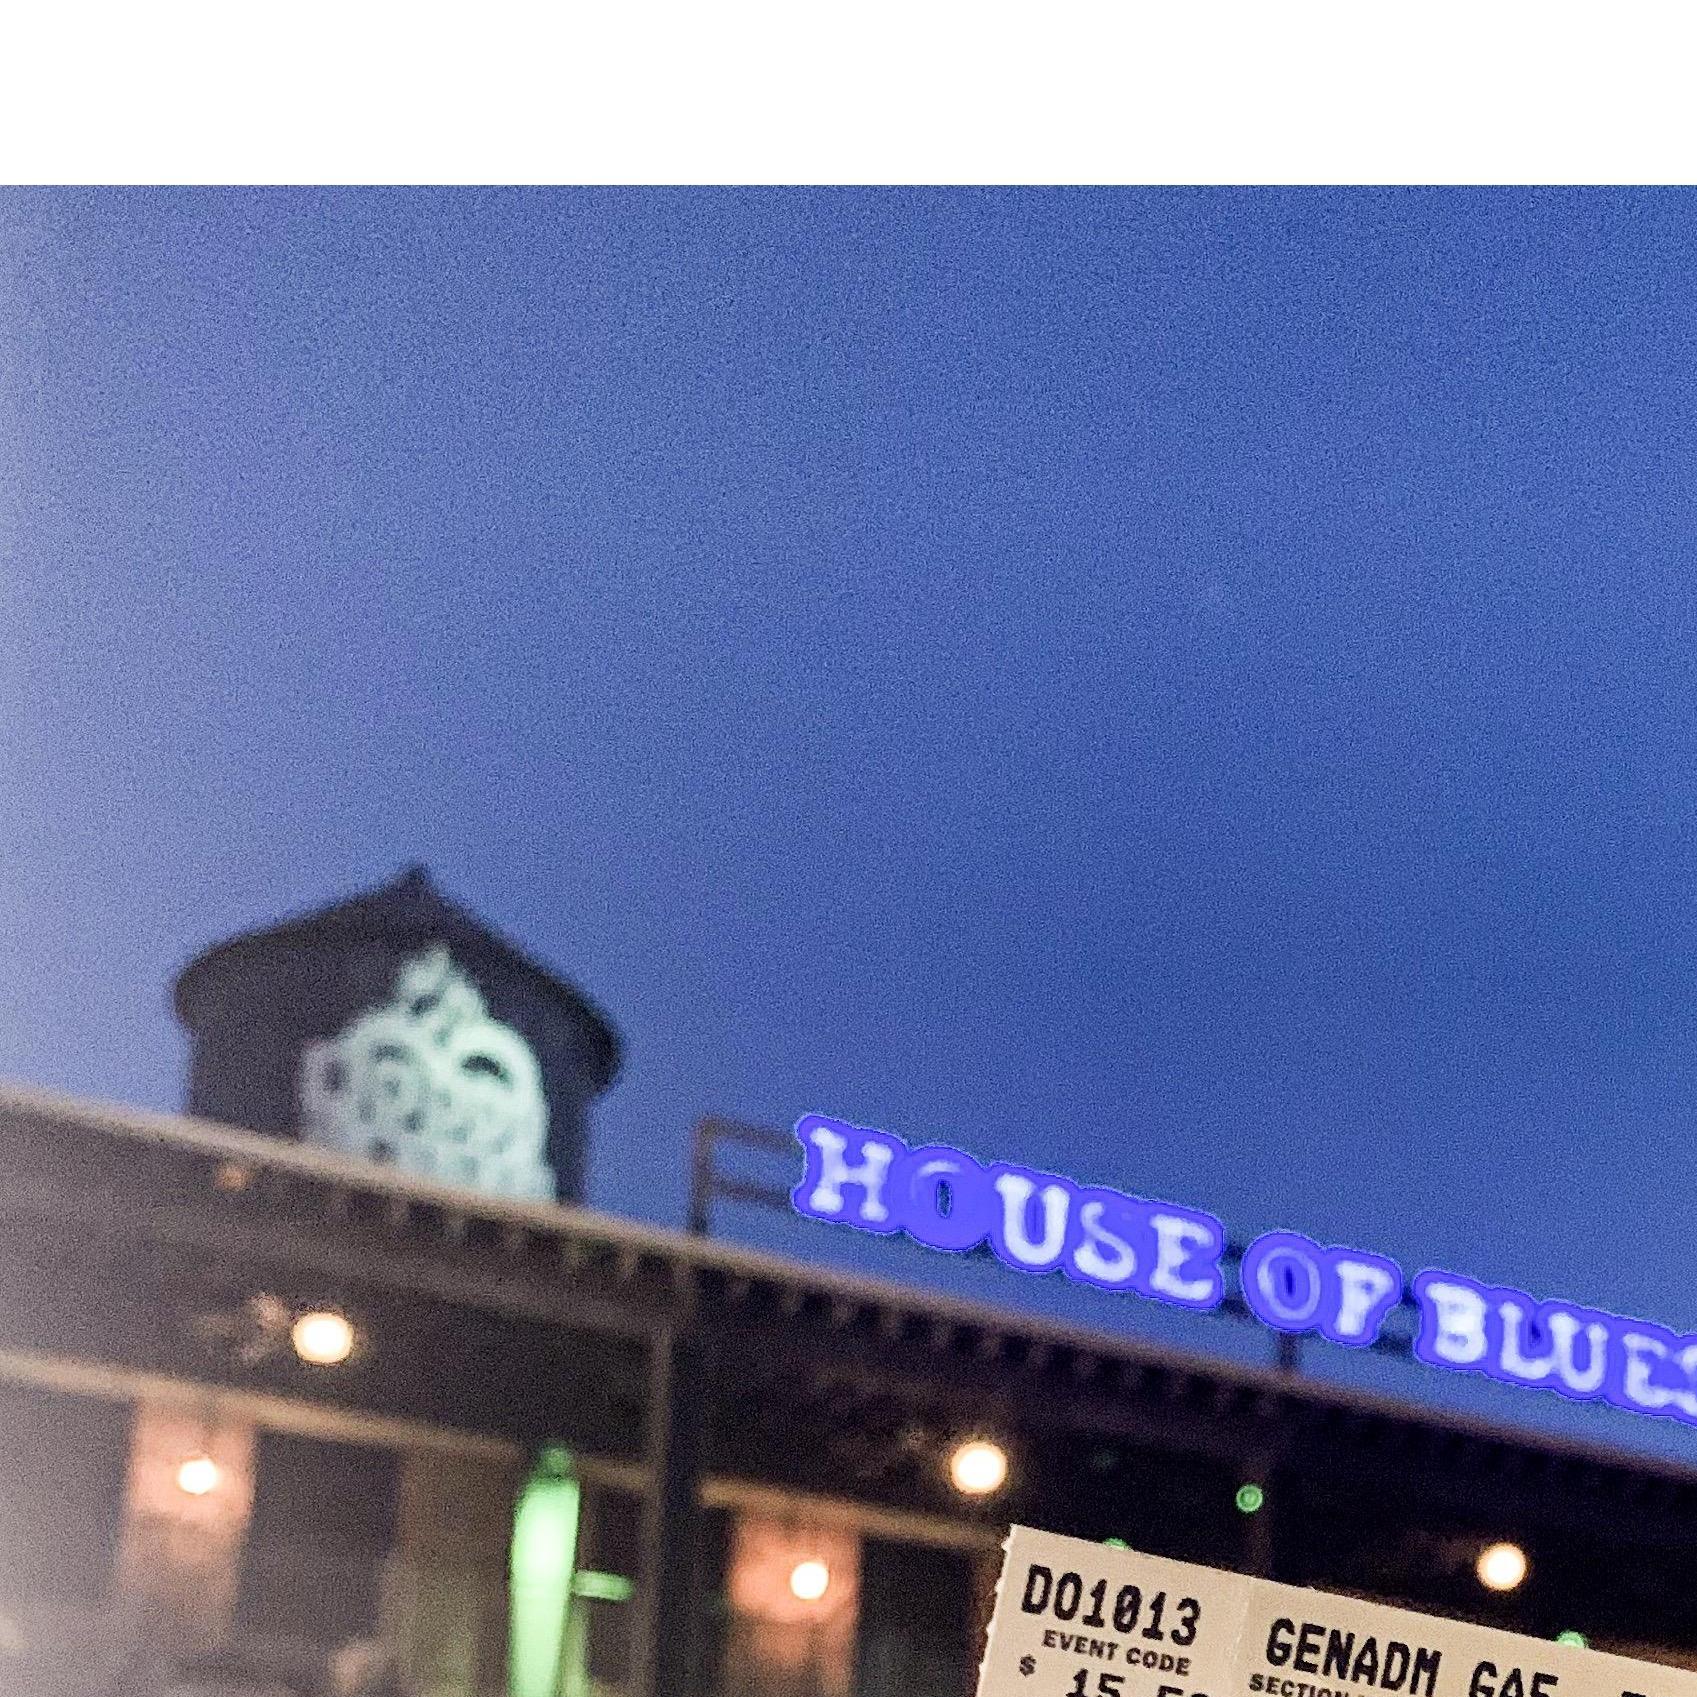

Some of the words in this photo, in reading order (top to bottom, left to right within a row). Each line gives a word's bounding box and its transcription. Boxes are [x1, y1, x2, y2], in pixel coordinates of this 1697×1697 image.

[803, 1120, 1218, 1304] HOUSE
[1018, 1654, 1037, 1676] $
[1042, 1629, 1119, 1661] EVENT
[1126, 1647, 1191, 1677] CODE
